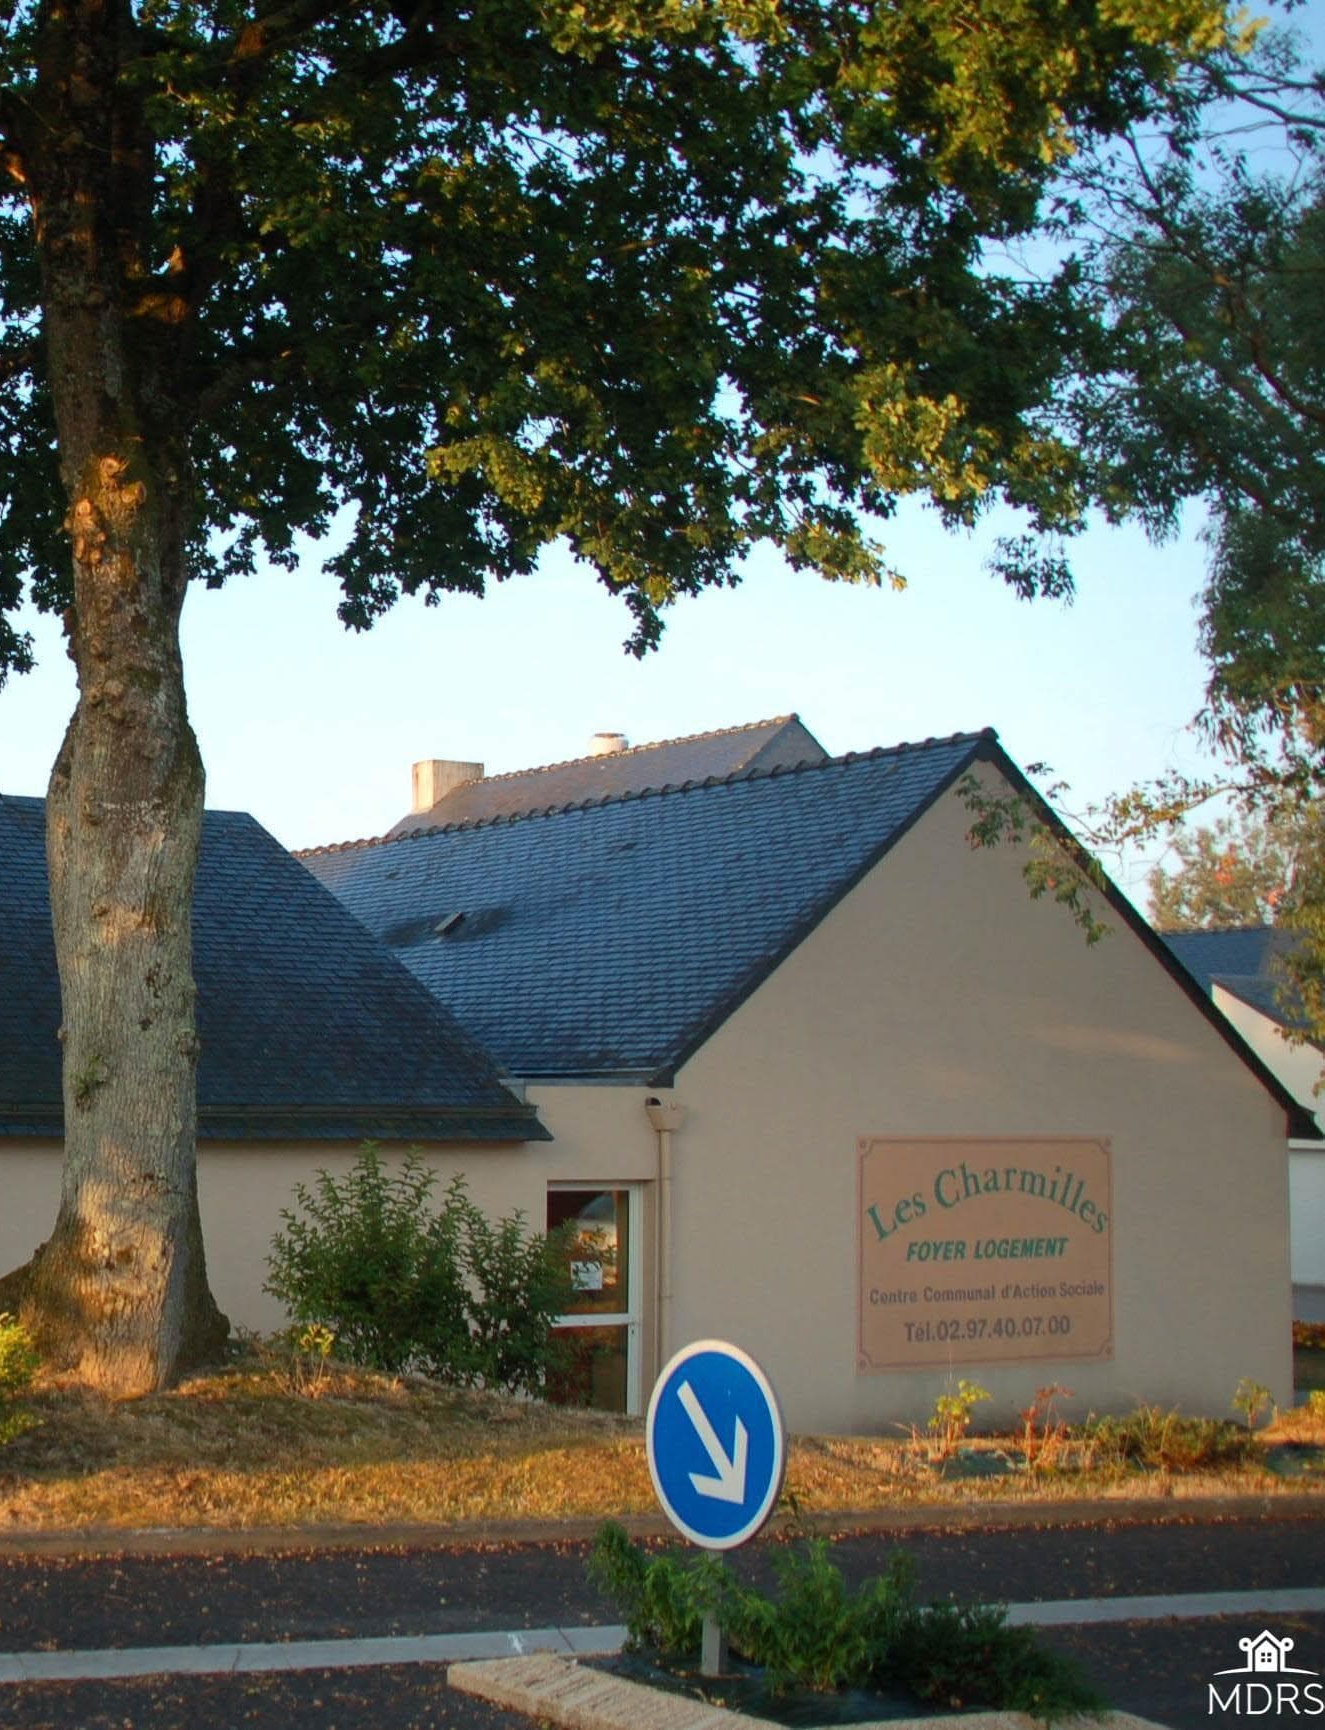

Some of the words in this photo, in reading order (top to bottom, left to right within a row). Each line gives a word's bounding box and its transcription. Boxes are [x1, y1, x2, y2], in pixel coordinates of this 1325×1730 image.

[867, 1192, 927, 1242] Les
[933, 1161, 1109, 1234] Charmilles
[906, 1240, 967, 1262] FOYER
[974, 1237, 1069, 1260] LOGEMENT
[869, 1288, 918, 1305] Centre
[923, 1285, 996, 1303] Communal
[1001, 1283, 1056, 1299] d'Action
[1059, 1280, 1106, 1298] Sociale
